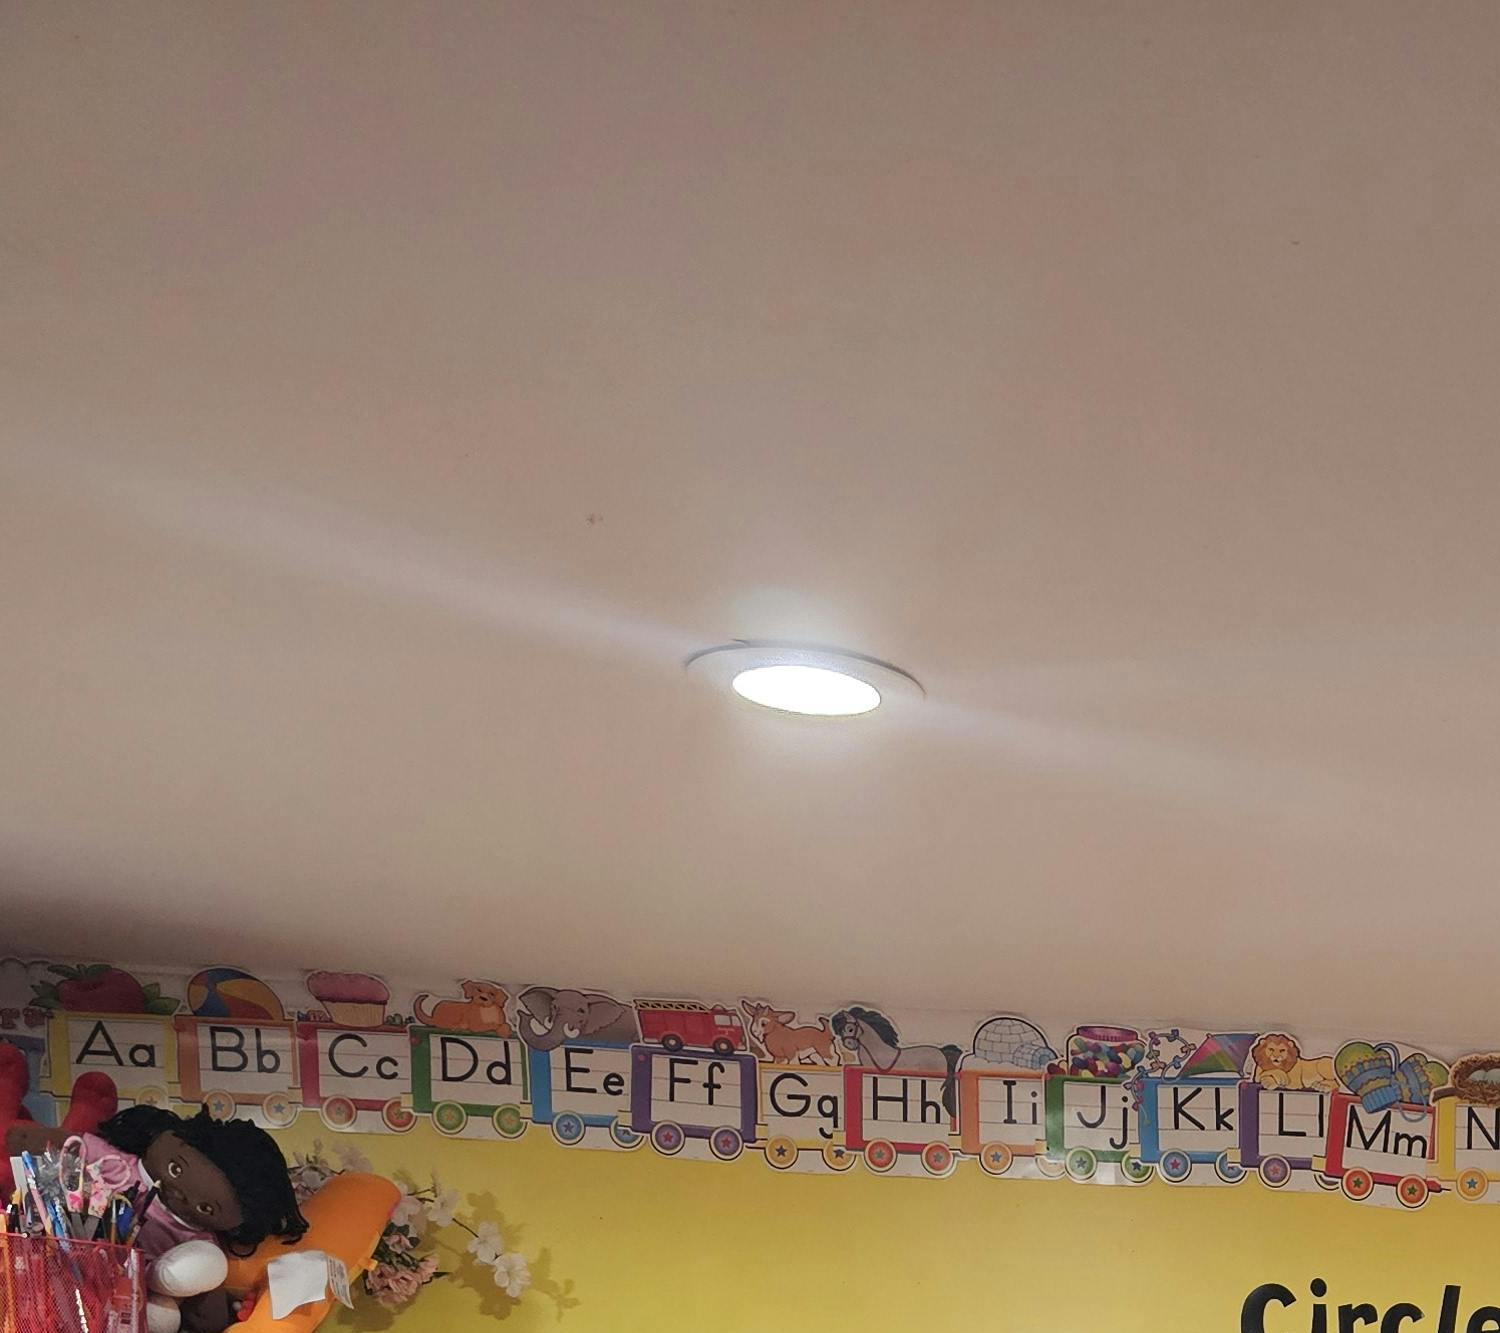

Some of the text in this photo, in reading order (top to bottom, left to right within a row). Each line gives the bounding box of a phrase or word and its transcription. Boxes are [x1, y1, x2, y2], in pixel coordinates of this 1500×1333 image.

[76, 1020, 157, 1068] Aa
[210, 1025, 282, 1074] Bb
[440, 1037, 512, 1086] Dd
[667, 1059, 726, 1106] Ff
[769, 1072, 840, 1138] Gg
[1076, 1083, 1130, 1151] Jj
[1172, 1086, 1234, 1132] Kk
[1345, 1103, 1428, 1158] Mm
